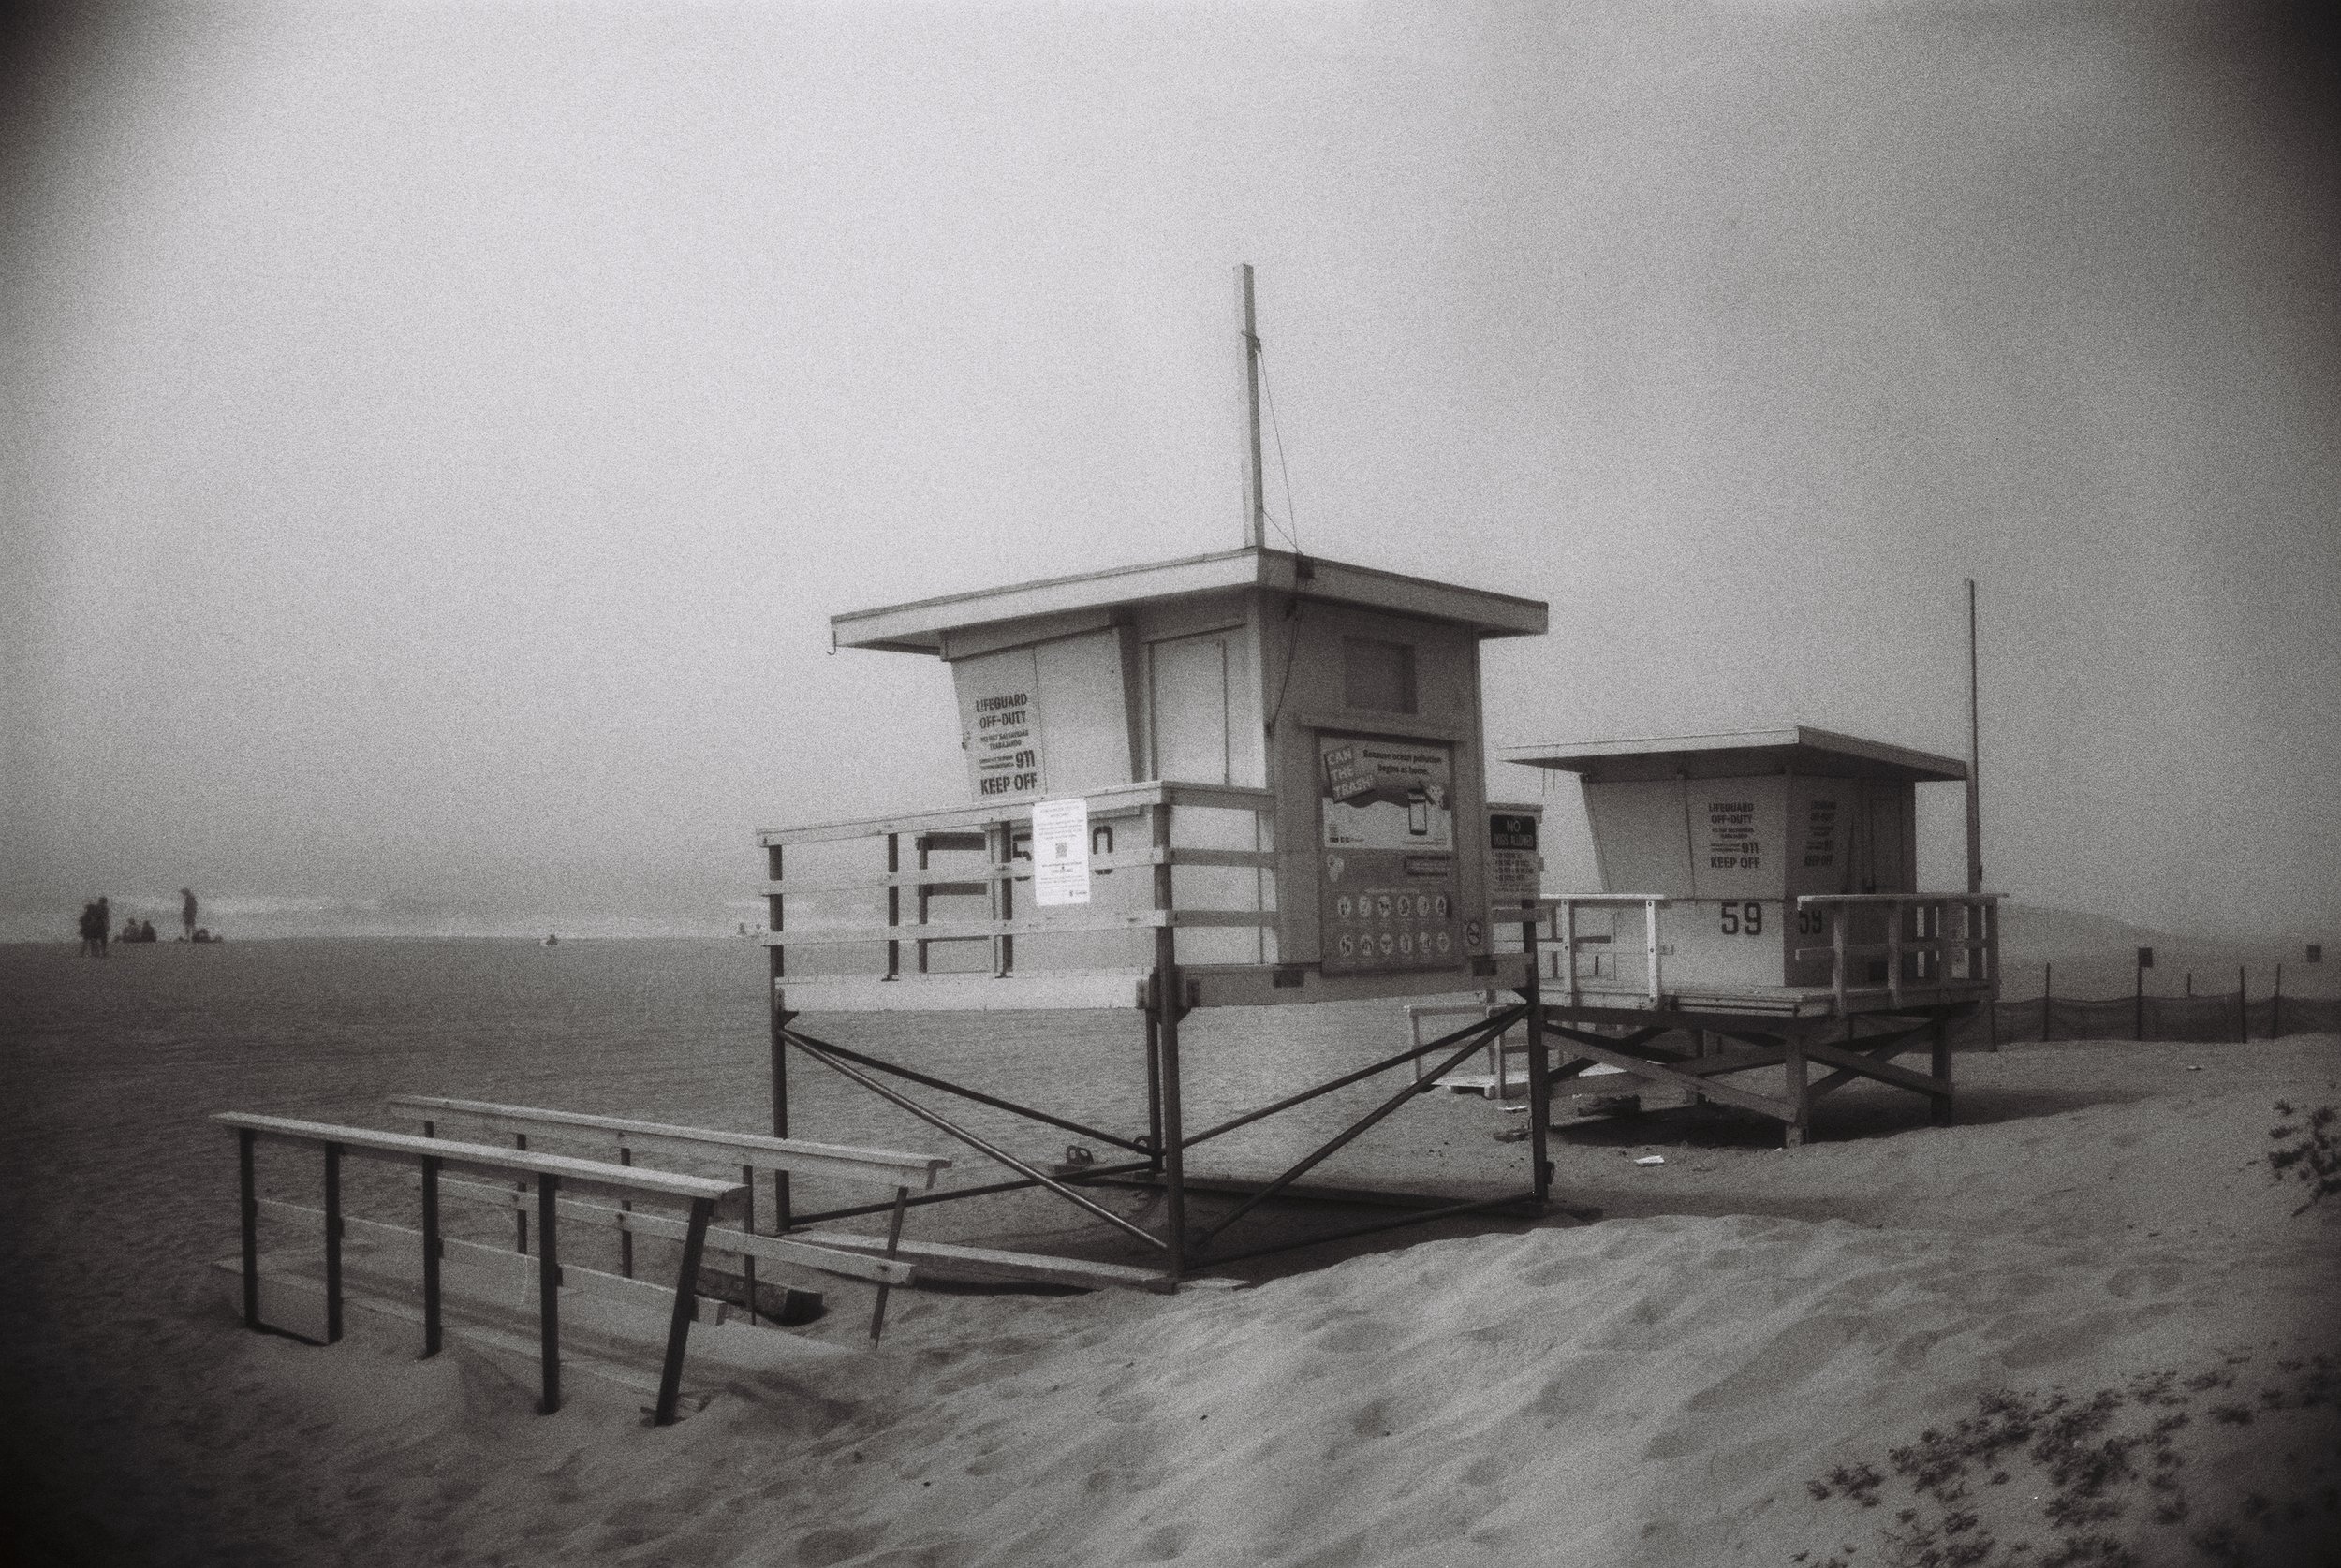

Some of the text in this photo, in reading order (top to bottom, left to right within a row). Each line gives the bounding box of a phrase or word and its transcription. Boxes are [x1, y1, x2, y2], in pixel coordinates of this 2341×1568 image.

[976, 693, 1028, 712] LIFEGUARD
[979, 711, 1026, 729] OFF-DUTY
[1015, 750, 1035, 768] 911
[1327, 748, 1352, 766] CAN
[1330, 764, 1354, 782] THE
[980, 772, 1037, 795] KEEP OFF
[1708, 802, 1754, 812] LIFEGUARD
[1507, 820, 1521, 832] NO
[1711, 813, 1753, 824] OFF-DUTY
[1742, 843, 1759, 854] 911
[1710, 857, 1760, 869] KEEP OFF
[1721, 901, 1762, 935] 59
[1798, 909, 1822, 934] 59
